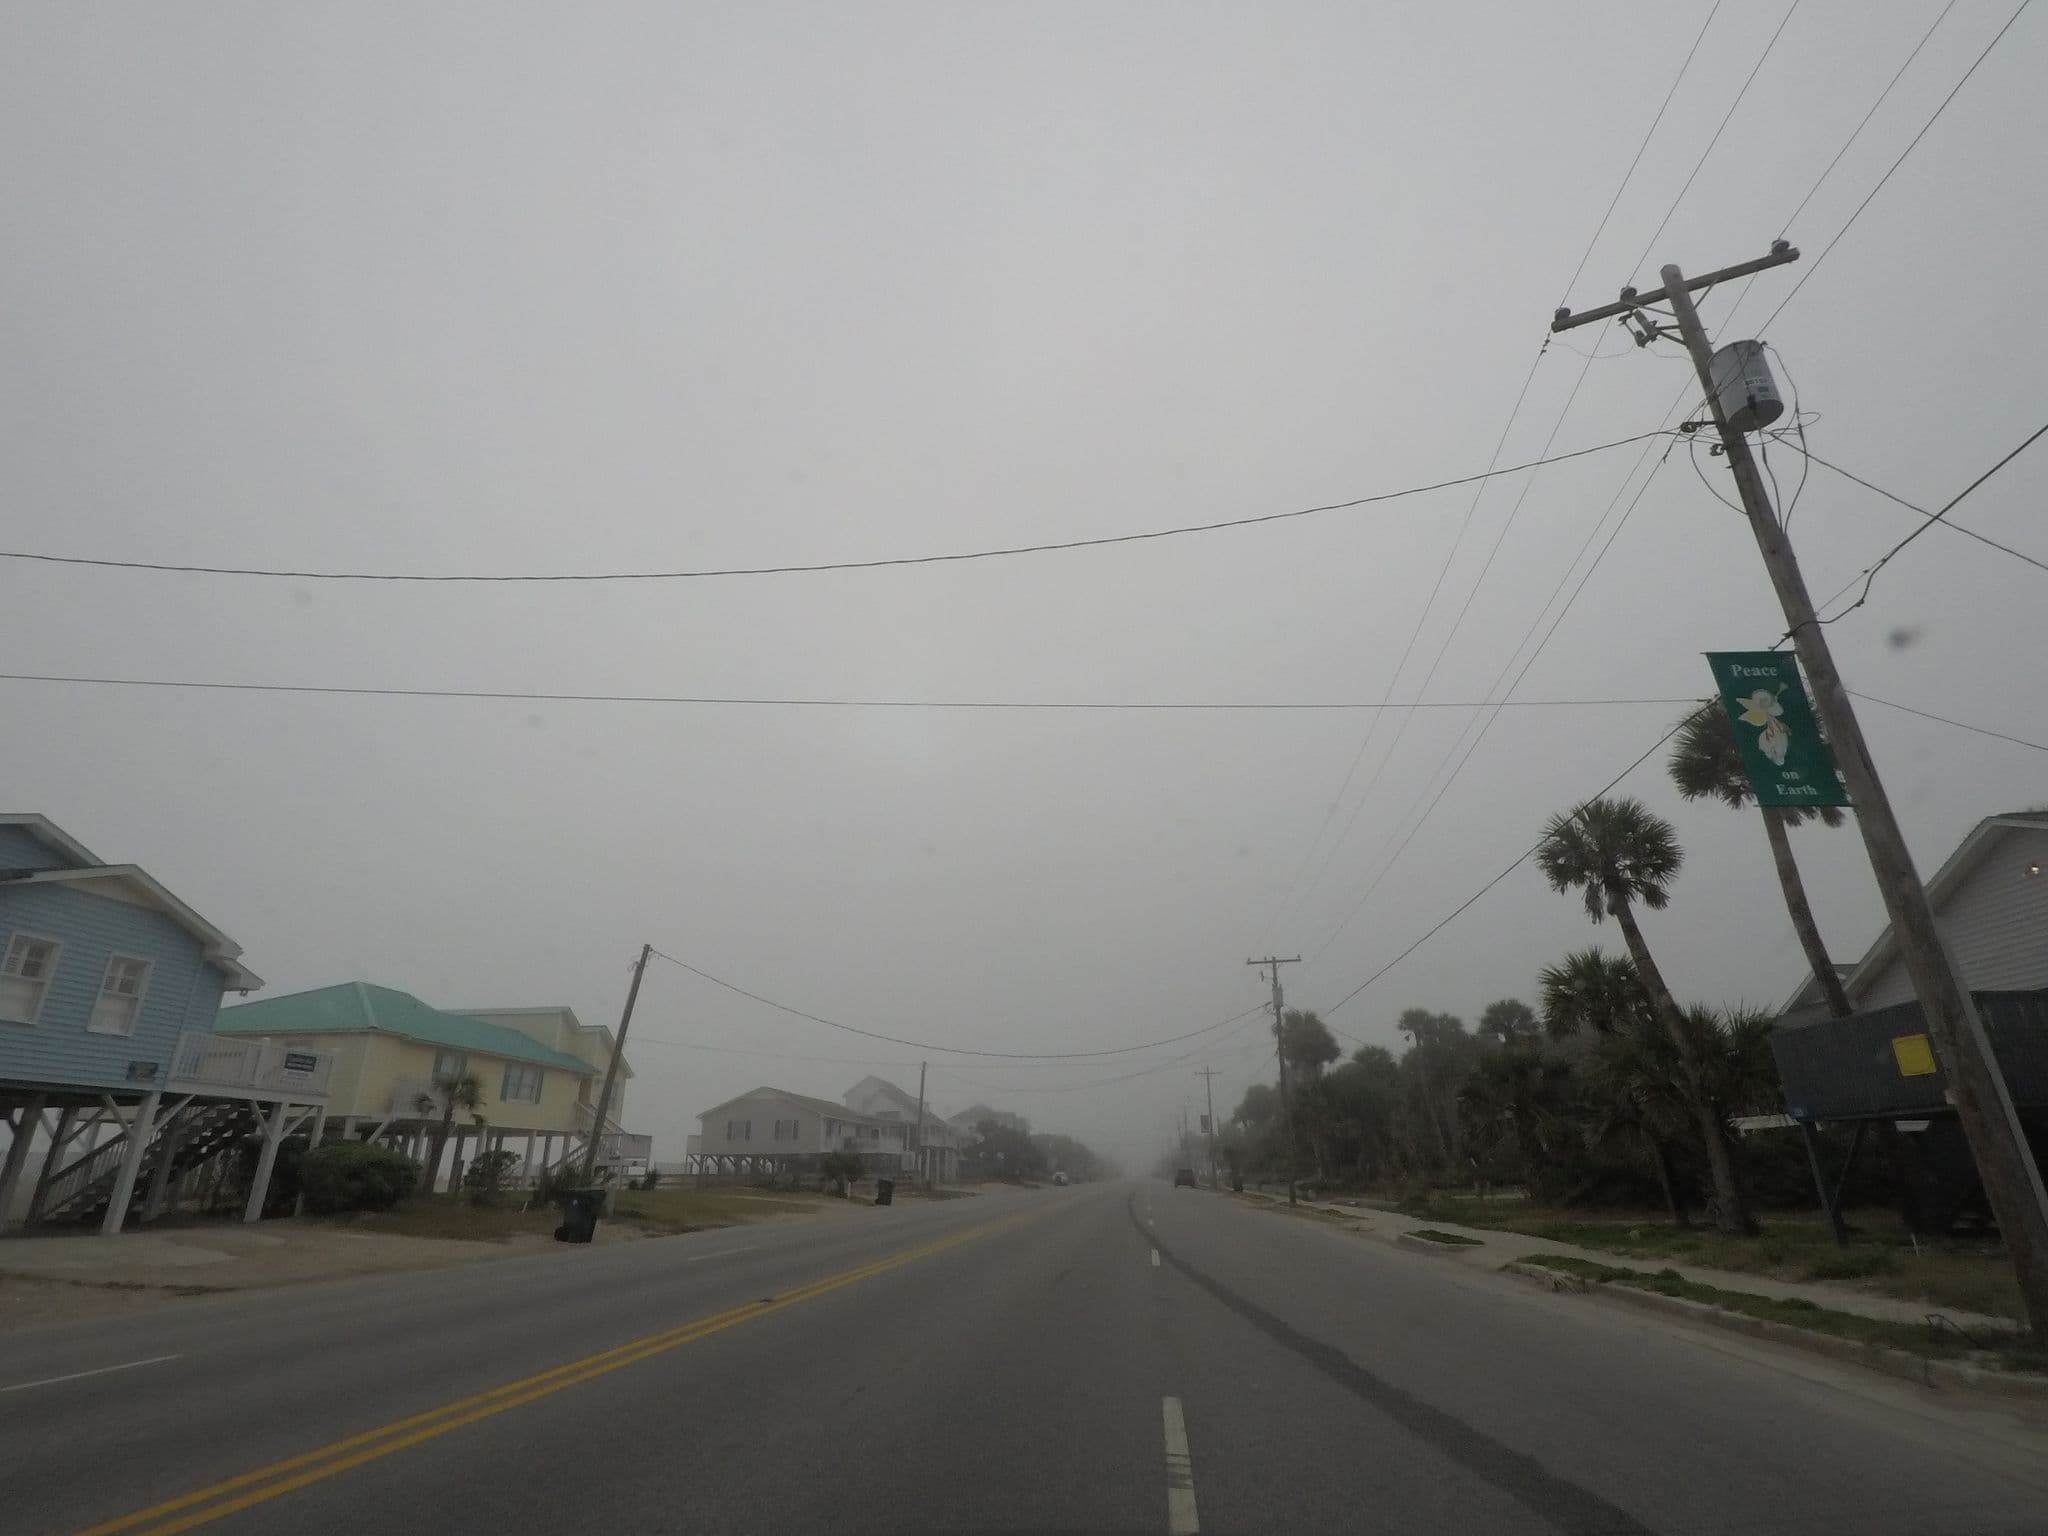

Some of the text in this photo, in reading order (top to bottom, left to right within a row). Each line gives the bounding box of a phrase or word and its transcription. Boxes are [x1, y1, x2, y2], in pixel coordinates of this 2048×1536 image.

[1730, 664, 1778, 677] Peace
[1782, 771, 1800, 780] on
[1776, 784, 1817, 796] Earth
